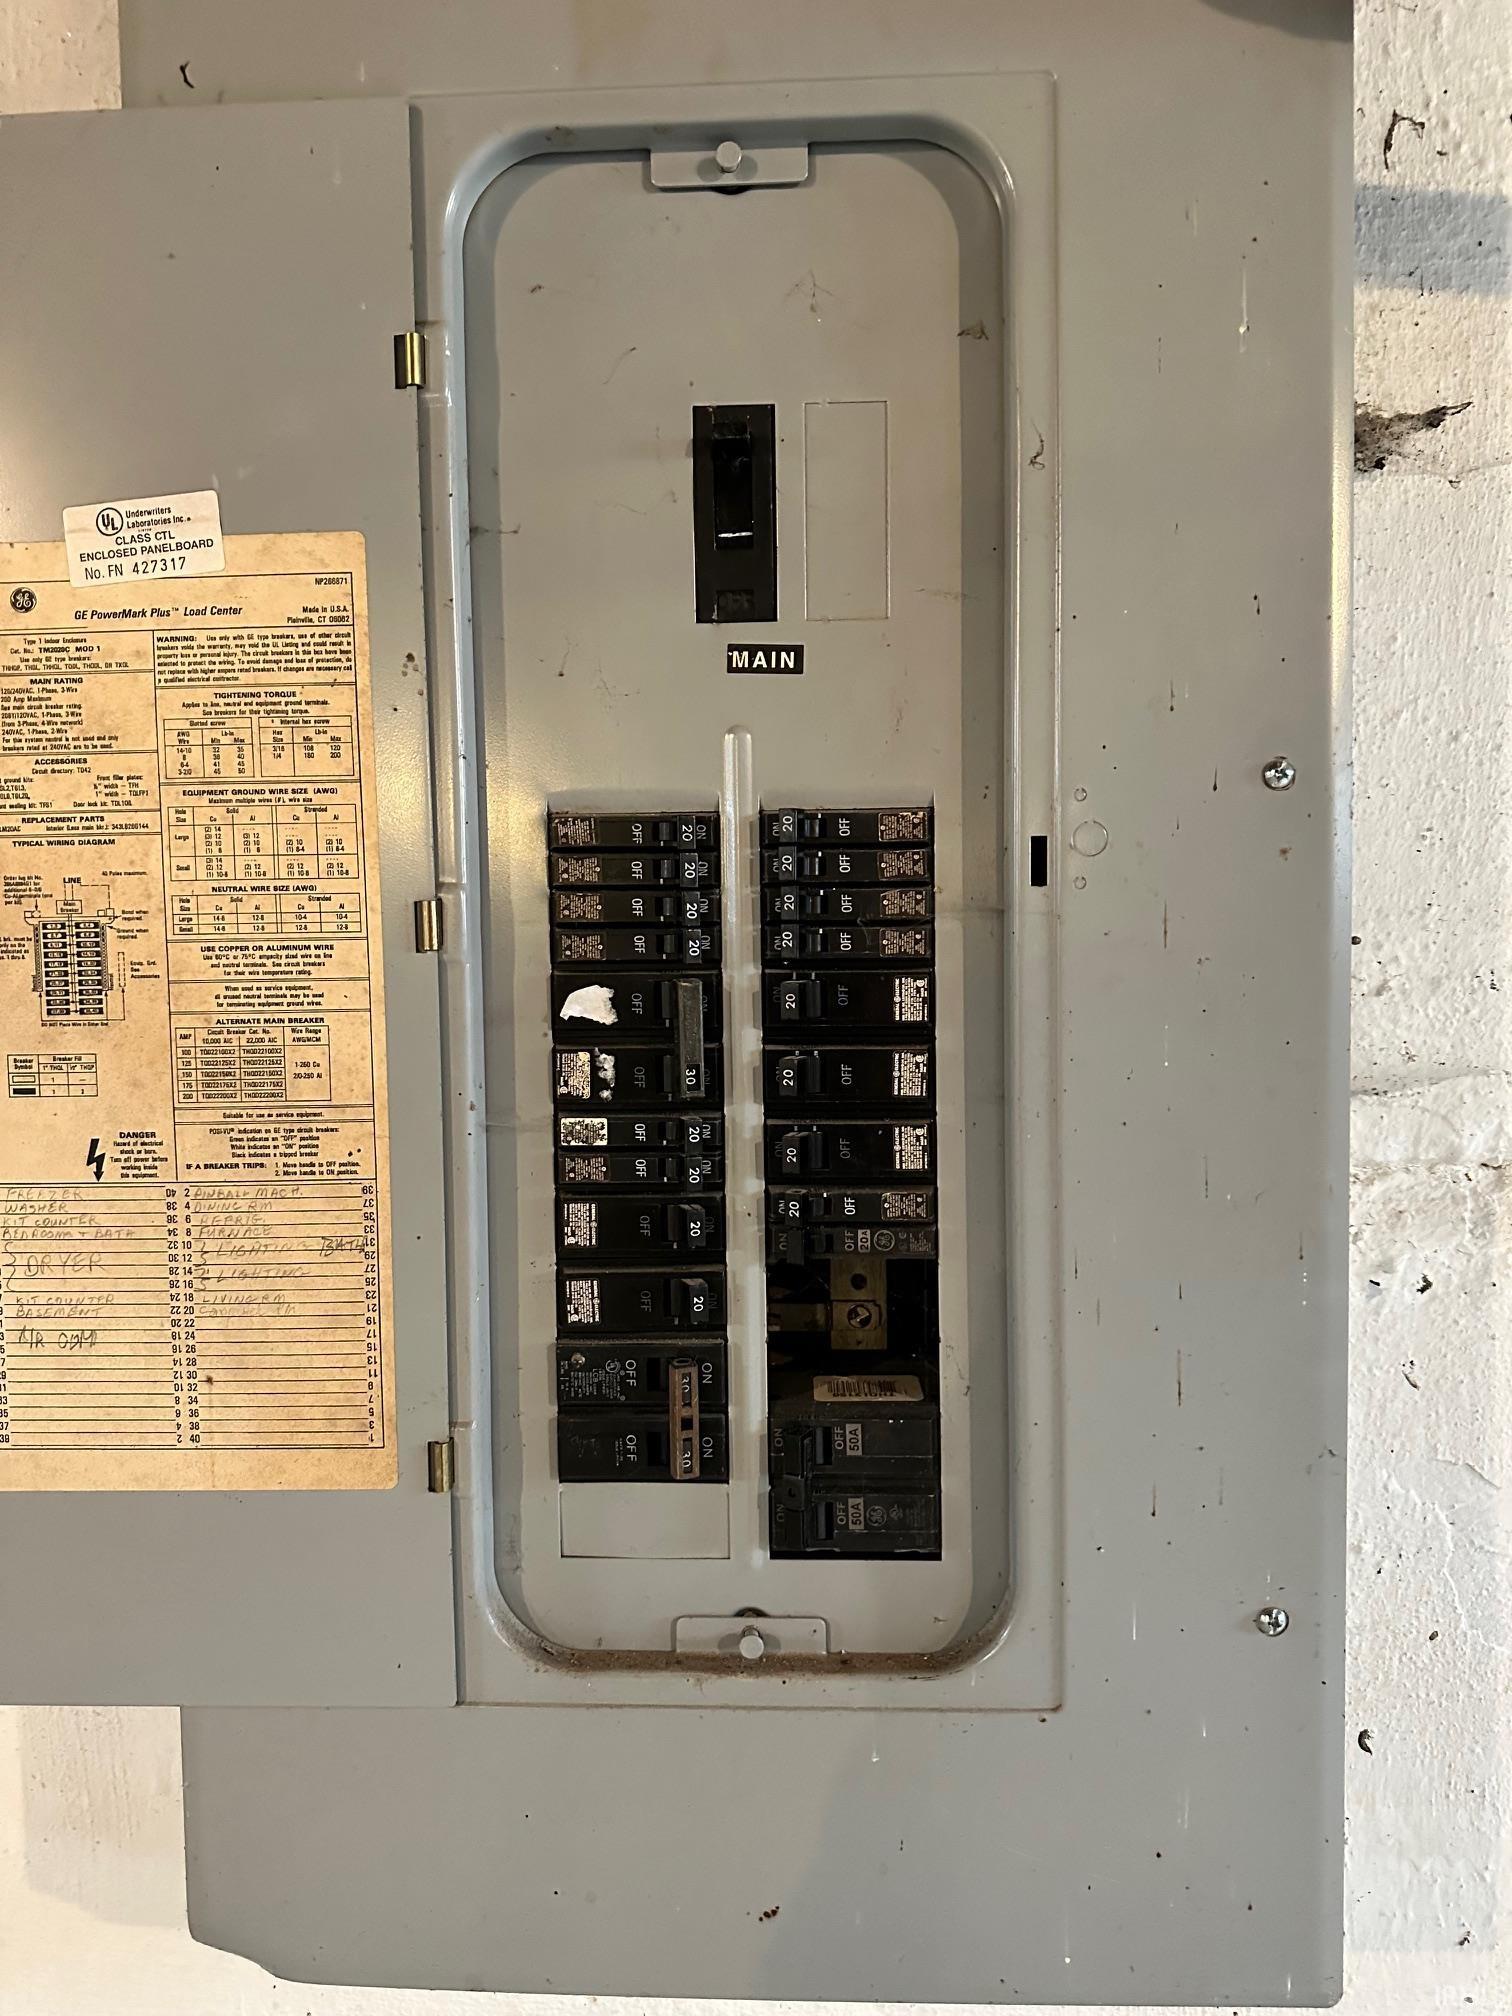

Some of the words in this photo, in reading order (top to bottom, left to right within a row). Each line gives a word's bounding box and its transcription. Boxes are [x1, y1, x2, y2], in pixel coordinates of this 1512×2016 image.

[125, 506, 171, 519] Underwriters
[126, 516, 171, 529] Laboratories
[115, 533, 151, 546] CLASS
[154, 530, 175, 541] CTL
[79, 547, 138, 562] ENCLOSED
[141, 538, 214, 556] PANELBOARD
[85, 567, 105, 580] No.
[108, 564, 123, 576] FN
[132, 556, 187, 575] 427317
[74, 610, 88, 620] GE
[91, 609, 147, 620] PowerMark
[184, 606, 207, 617] Load
[210, 606, 243, 616] Center
[302, 606, 320, 614] Made
[731, 650, 796, 669] MAIN
[313, 787, 338, 795] (AWG)
[21, 816, 77, 824] REPLACEMENT
[79, 815, 105, 823] PARTS
[782, 815, 794, 832] 20
[838, 817, 851, 837] OFF
[631, 823, 643, 844] OFF
[682, 824, 693, 842] 20
[12, 840, 45, 848] TYPICAL
[78, 838, 116, 846] DIAGRAM
[631, 861, 643, 880] OFF
[684, 862, 696, 879] 20
[781, 854, 793, 872] 20
[839, 854, 851, 873] OFF
[211, 885, 248, 893] NEUTRAL
[292, 884, 317, 892] (AWG)
[631, 898, 644, 917] OFF
[686, 902, 698, 919] 20
[783, 893, 795, 911] 20
[841, 893, 853, 913] OFF
[633, 935, 646, 954] OFF
[688, 939, 700, 956] 20
[781, 930, 793, 948] 20
[840, 931, 852, 951] OFF
[200, 945, 217, 953] USE
[313, 943, 335, 951] WIRE
[631, 992, 643, 1015] OFF
[785, 993, 796, 1009] 20
[837, 984, 849, 1006] OFF
[288, 1016, 325, 1024] BREAKER
[633, 1066, 646, 1088] OFF
[685, 1068, 696, 1085] 30
[782, 1069, 794, 1086] 20
[841, 1063, 852, 1085] OFF
[119, 1131, 157, 1139] DANGER
[634, 1123, 646, 1142] OFF
[688, 1126, 700, 1143] 20
[786, 1147, 797, 1163] 20
[839, 1137, 851, 1159] OFF
[203, 1162, 240, 1170] BREAKER
[635, 1159, 647, 1178] OFF
[688, 1167, 700, 1184] 20
[184, 1188, 191, 1197] 2
[184, 1201, 191, 1210] 4
[788, 1201, 800, 1218] 20
[844, 1196, 856, 1215] OFF
[185, 1214, 192, 1223] 6
[639, 1215, 651, 1237] OFF
[185, 1227, 192, 1236] 8
[690, 1221, 701, 1237] 20
[182, 1240, 192, 1249] 10
[844, 1230, 855, 1251] OFF
[182, 1253, 193, 1262] 12
[183, 1266, 193, 1275] 14
[183, 1280, 194, 1288] 16
[184, 1293, 194, 1301] 18
[640, 1290, 652, 1313] OFF
[693, 1296, 704, 1312] 20
[184, 1306, 195, 1314] 20
[184, 1319, 195, 1327] 22
[184, 1331, 196, 1340] 24
[185, 1344, 197, 1353] 26
[186, 1357, 197, 1366] 28
[186, 1370, 198, 1379] 30
[625, 1359, 638, 1387] OFF
[701, 1362, 714, 1384] ON
[187, 1383, 199, 1391] 32
[188, 1396, 199, 1404] 34
[188, 1409, 200, 1417] 36
[189, 1421, 200, 1430] 38
[189, 1434, 201, 1443] 40
[774, 1427, 784, 1448] ON
[834, 1425, 845, 1450] OFF
[849, 1428, 860, 1451] 50A
[625, 1434, 639, 1462] OFF
[701, 1436, 714, 1459] ON
[836, 1502, 847, 1525] OFF
[851, 1502, 862, 1526] 50A
